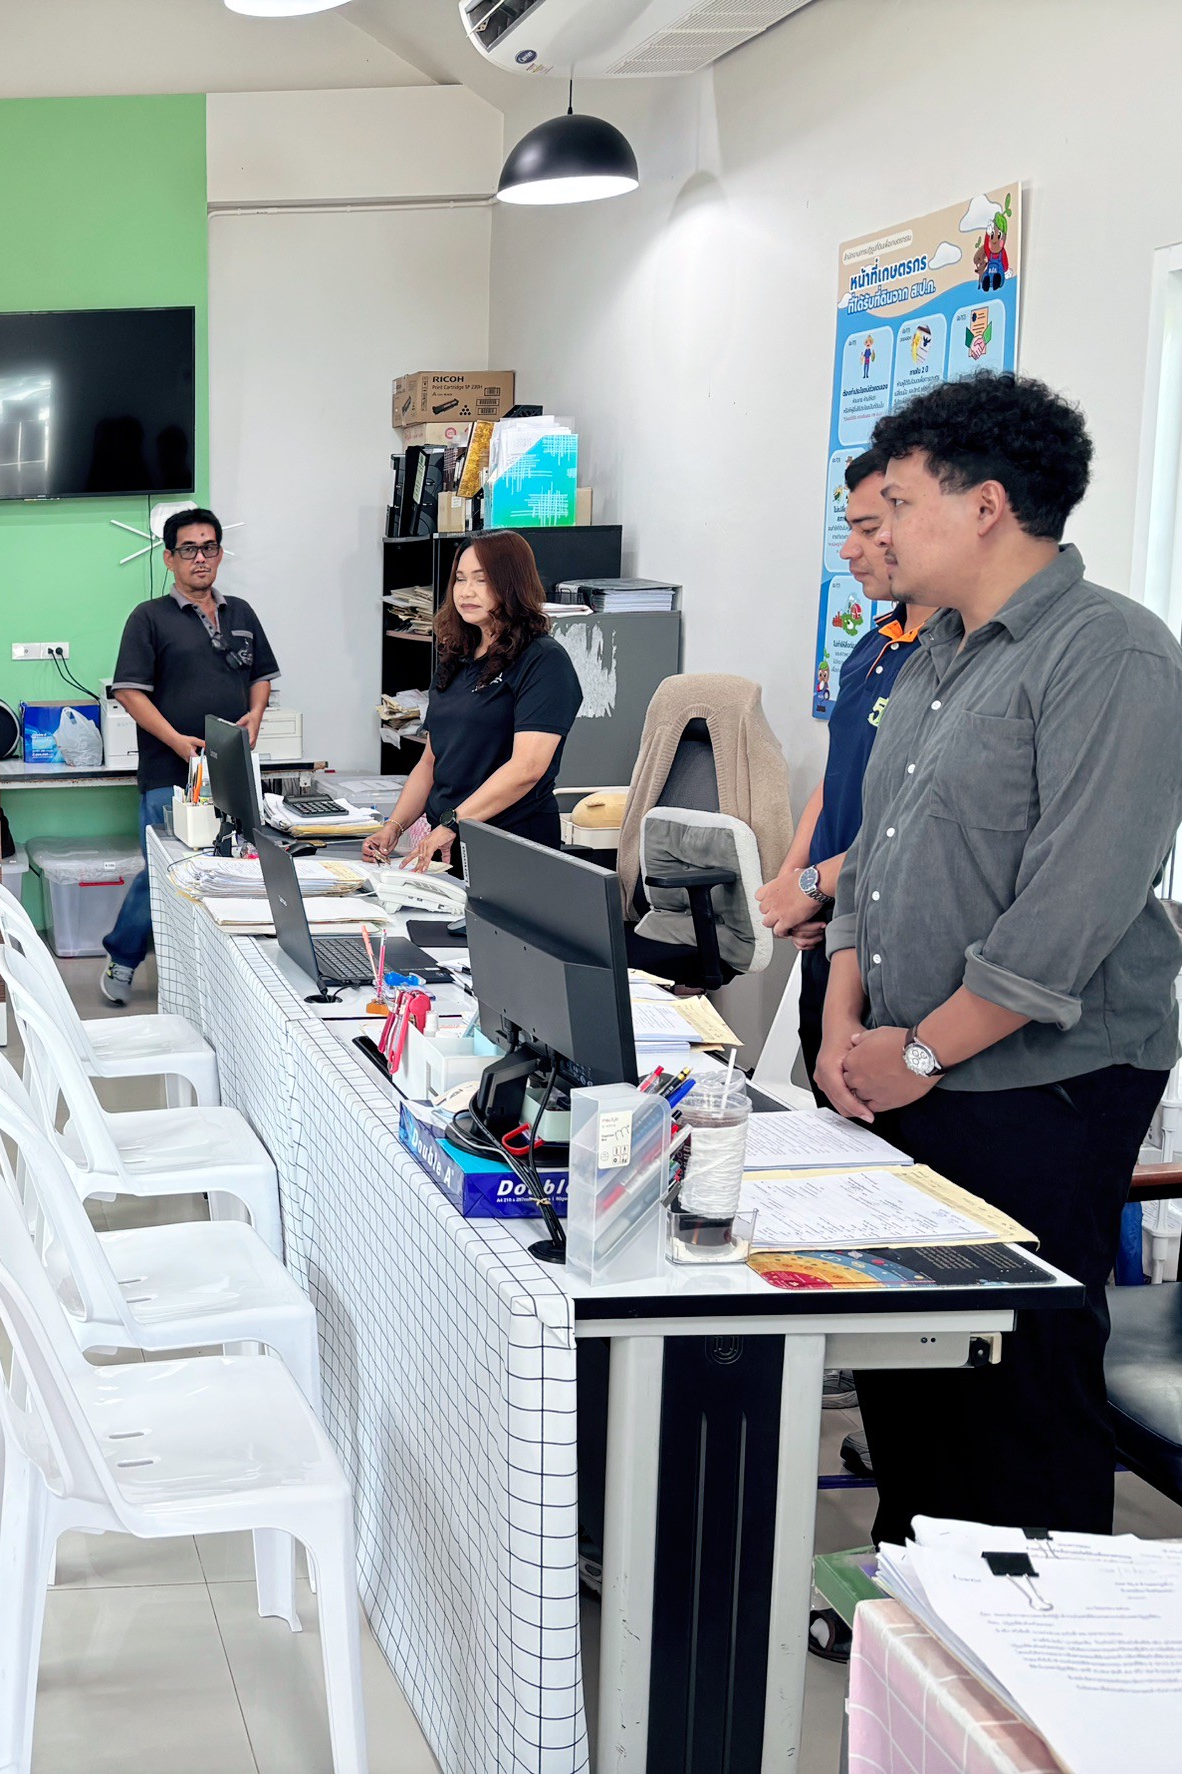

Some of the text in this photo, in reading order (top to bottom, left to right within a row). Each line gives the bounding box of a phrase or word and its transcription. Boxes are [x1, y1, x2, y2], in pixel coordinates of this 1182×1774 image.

[850, 255, 927, 290] หน้าที่เกษตรกร
[847, 285, 908, 315] ที่ได้รับที่ดินจาก
[432, 375, 464, 383] RICOH
[412, 1128, 451, 1188] Double A
[496, 1178, 568, 1196] Dobl
